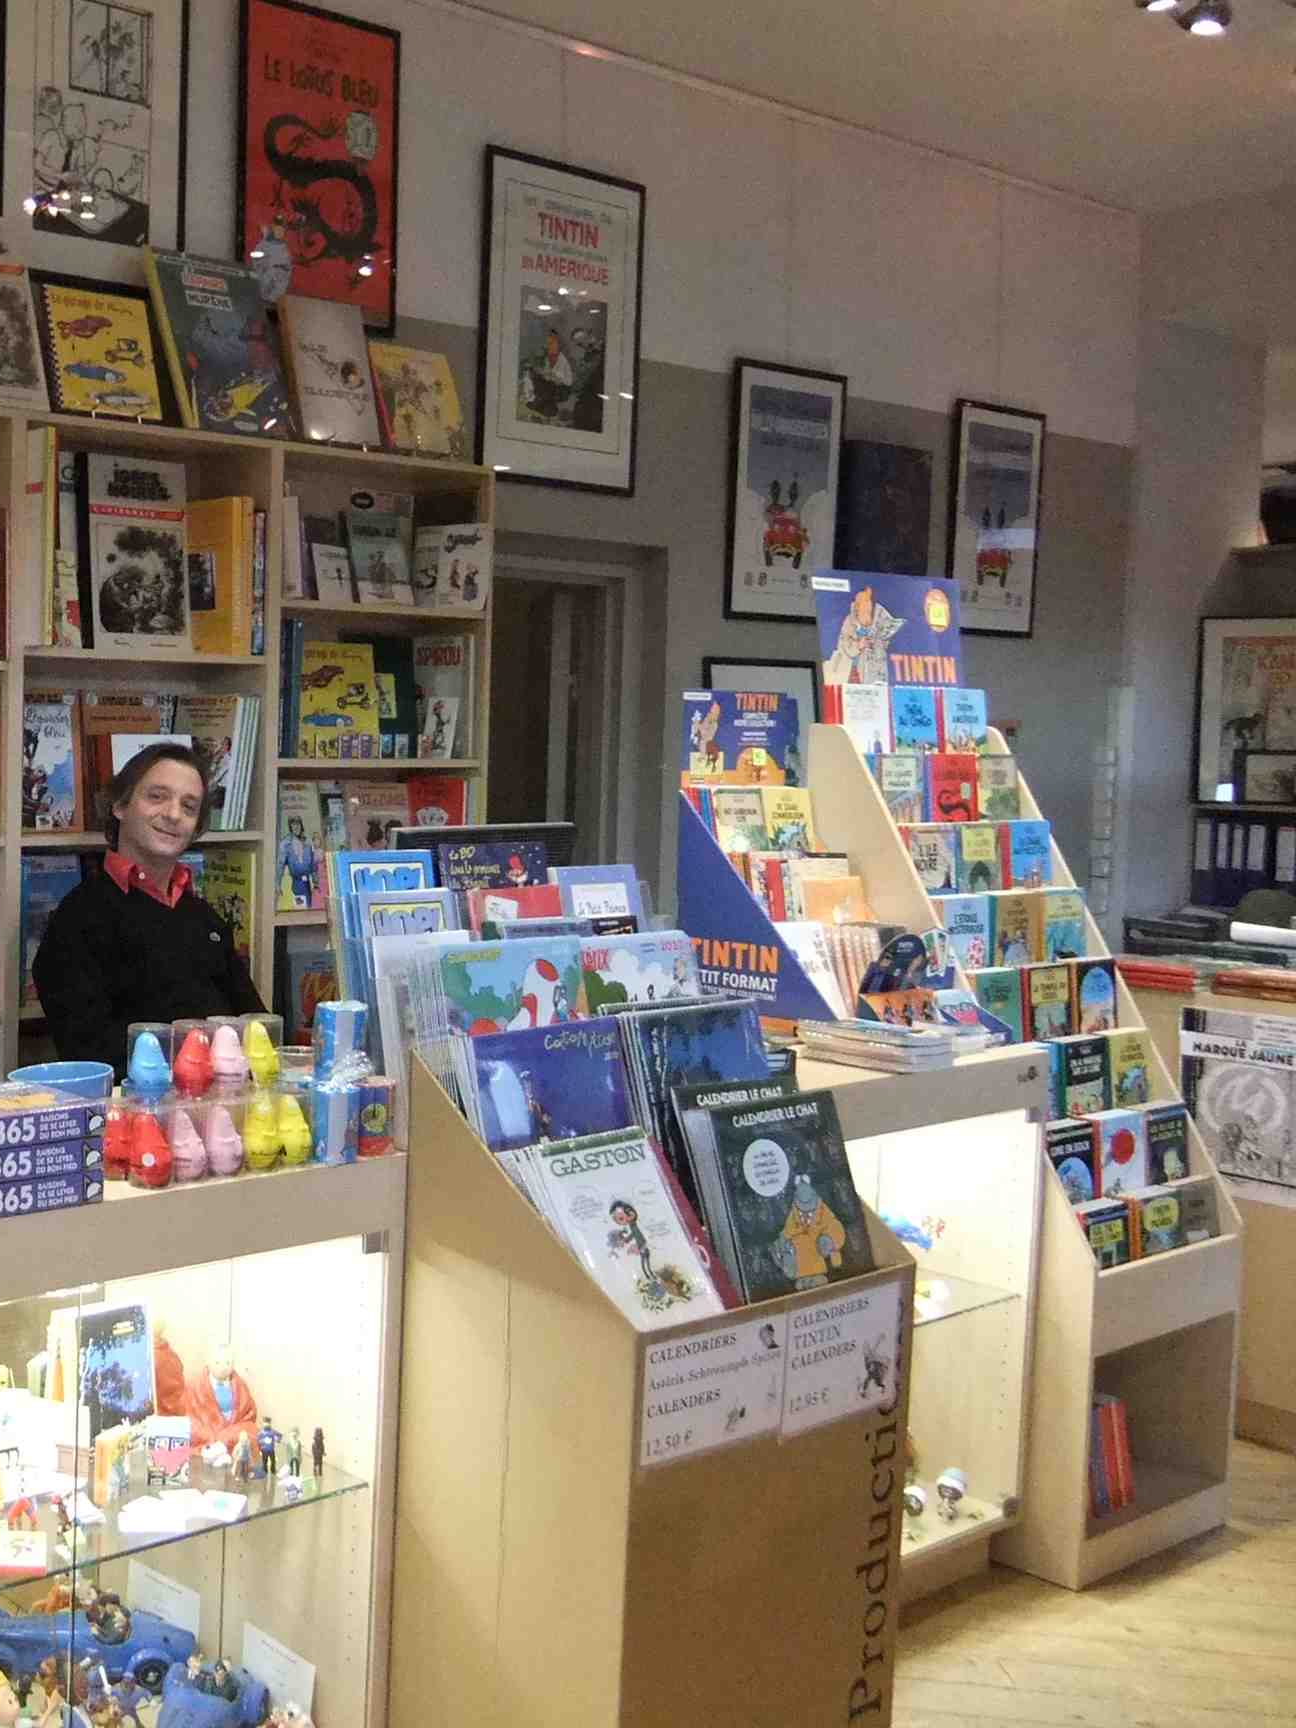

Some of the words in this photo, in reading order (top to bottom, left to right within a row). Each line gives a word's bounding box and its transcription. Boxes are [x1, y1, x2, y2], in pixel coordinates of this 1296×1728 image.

[289, 60, 335, 97] LOTUS
[341, 74, 379, 108] BLEU
[537, 212, 599, 248] TINTIN
[890, 654, 957, 683] TINTIN
[735, 693, 779, 713] TINTIN
[701, 969, 719, 986] TIT
[723, 972, 779, 991] FORMAT
[1192, 1042, 1246, 1060] MARQUE
[1249, 1049, 1294, 1067] JAUNE
[696, 1089, 746, 1106] CALENDRIER
[748, 1089, 758, 1101] LE
[760, 1087, 782, 1099] CHAT
[732, 1110, 781, 1127] CALENDRIER
[783, 1108, 792, 1119] LE
[794, 1104, 818, 1118] CHAT
[549, 1143, 646, 1177] GASTON
[794, 1297, 870, 1329] CALENDRIERS
[650, 1333, 737, 1364] CALENDRIERS
[794, 1324, 841, 1350] TINTIN
[792, 1339, 857, 1370] CALENDERS
[647, 1389, 721, 1418] CALENDERS
